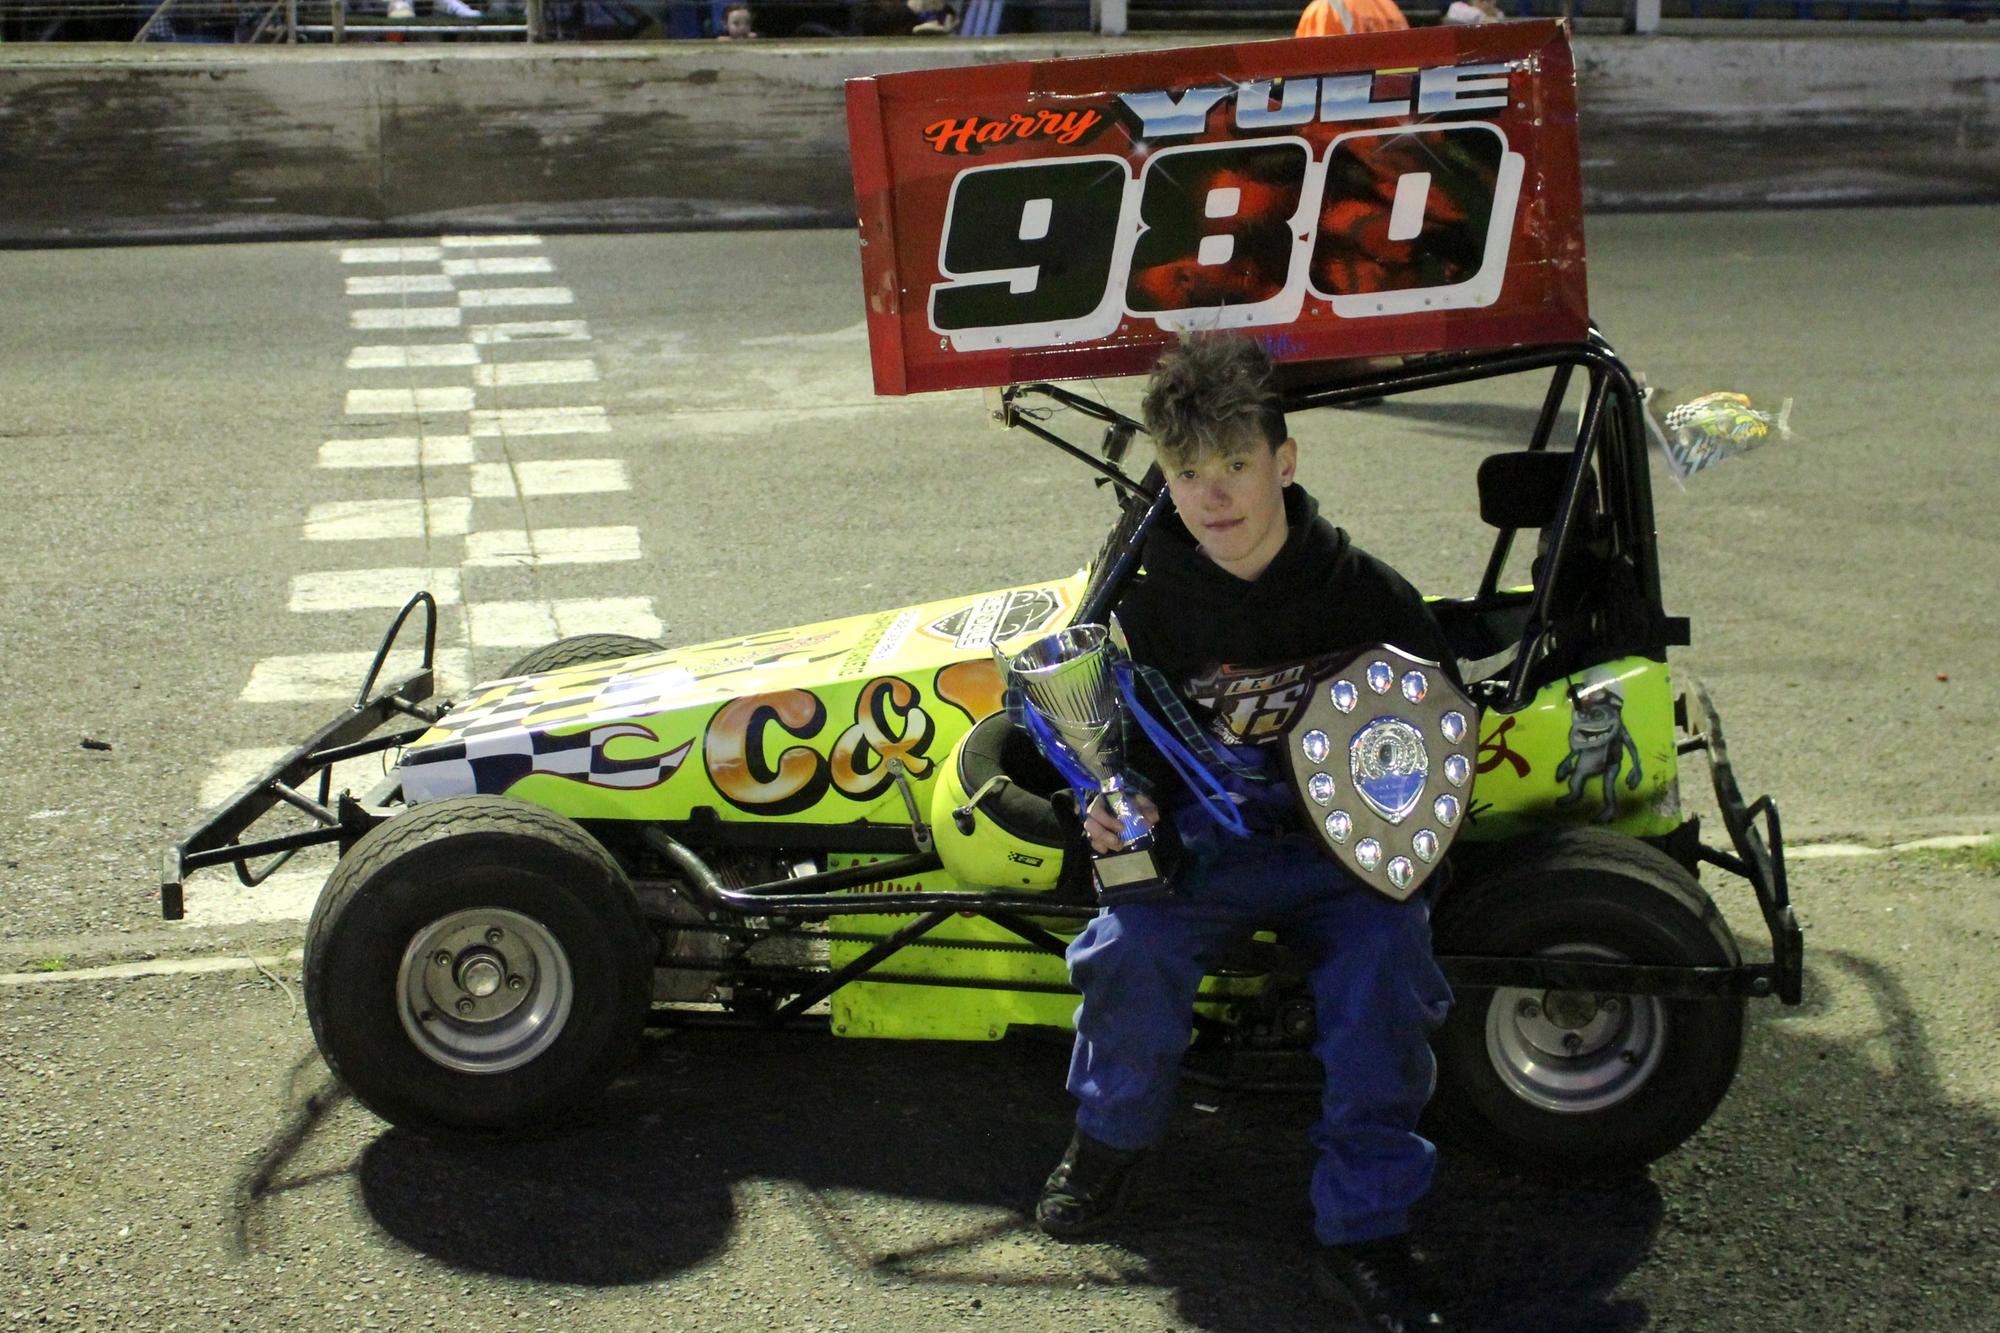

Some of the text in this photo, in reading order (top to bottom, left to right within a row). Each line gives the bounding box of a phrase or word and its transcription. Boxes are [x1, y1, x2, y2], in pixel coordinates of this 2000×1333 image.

[923, 62, 1510, 153] Harry YULE
[927, 120, 1525, 352] 980
